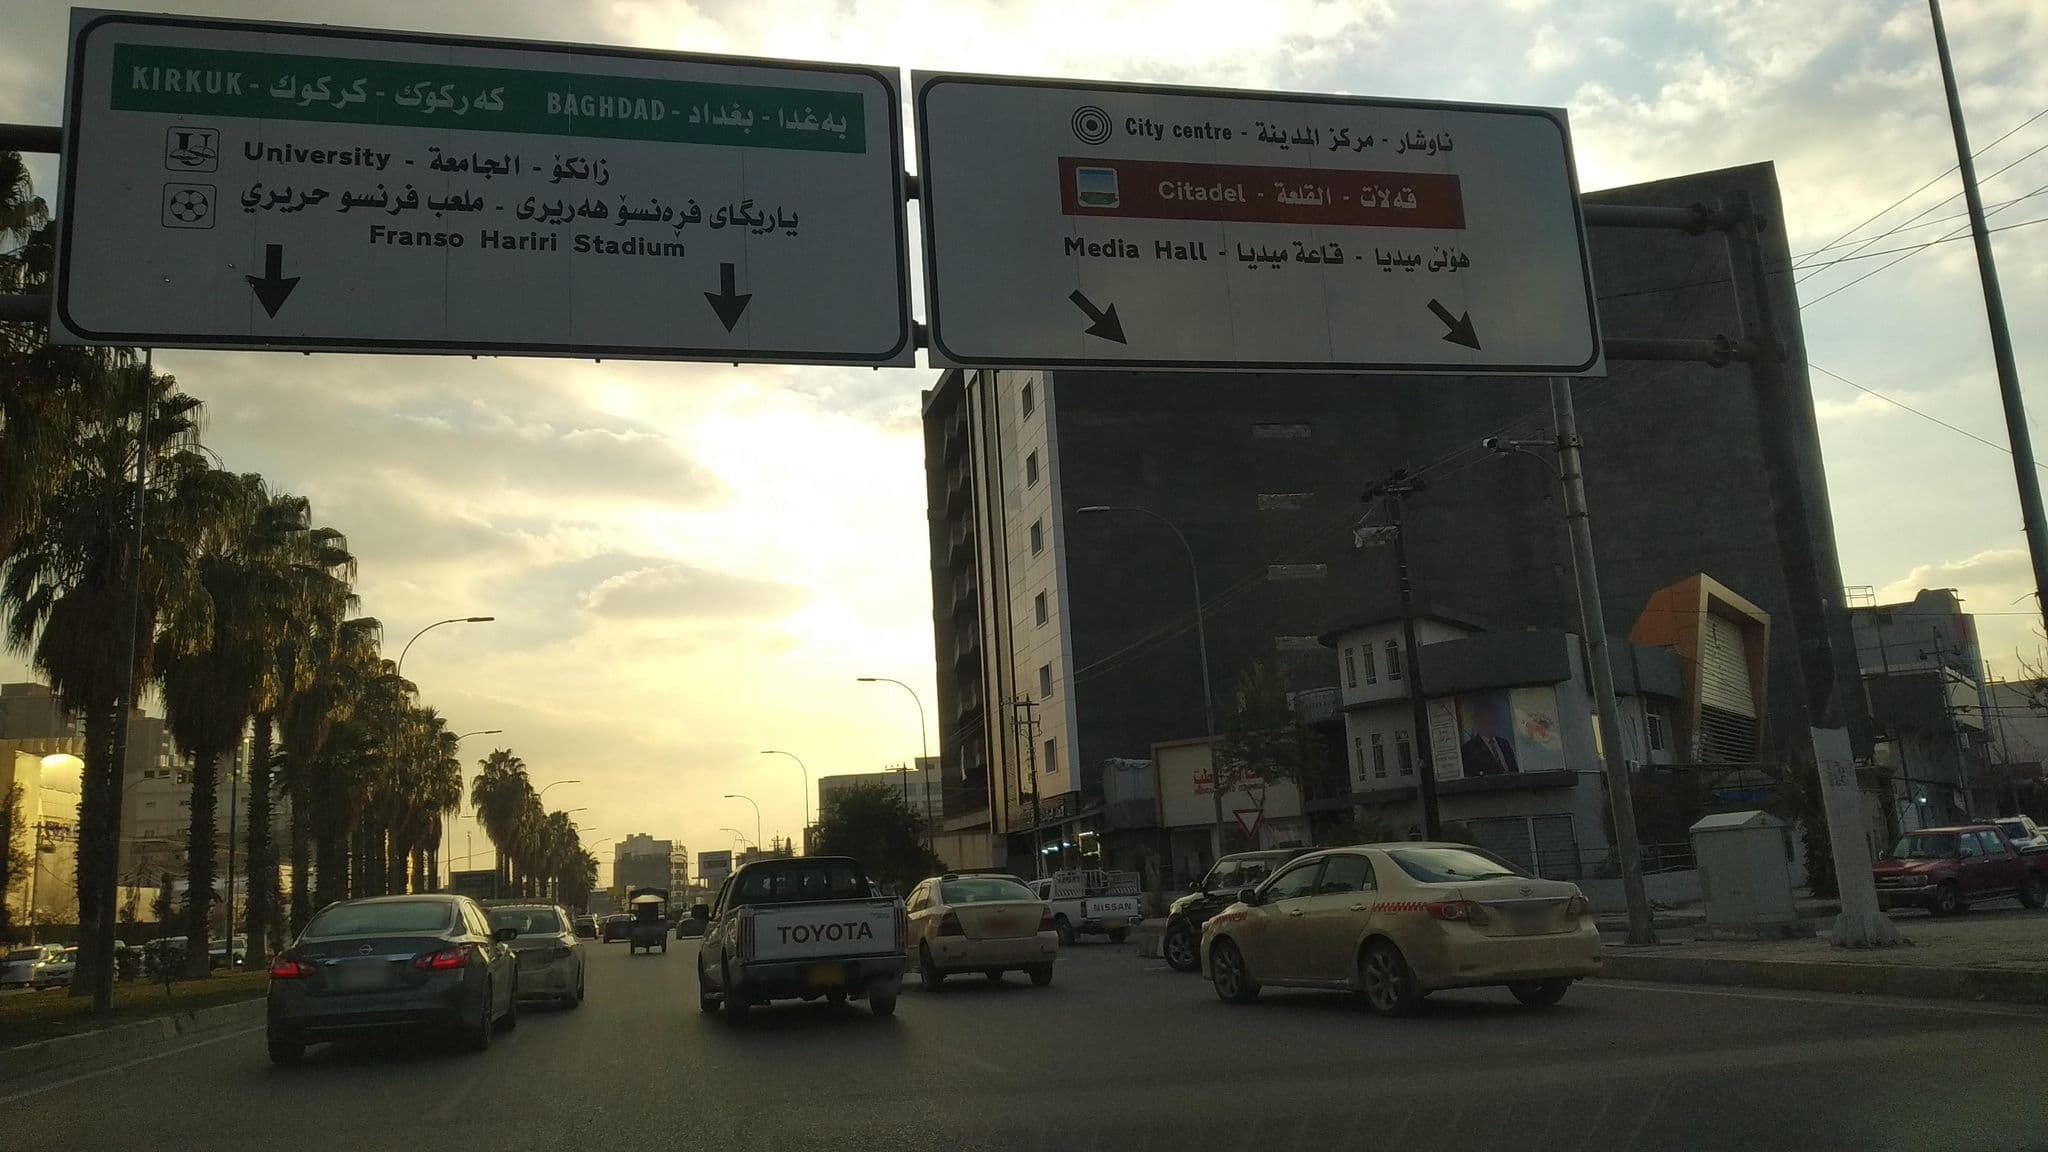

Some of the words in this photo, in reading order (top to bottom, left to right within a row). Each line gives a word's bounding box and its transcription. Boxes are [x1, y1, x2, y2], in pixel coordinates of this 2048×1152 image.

[132, 66, 244, 96] KIRKUK
[269, 74, 368, 109] كركوك
[546, 91, 665, 121] BAGHDAD
[688, 102, 753, 135] بغداد
[1126, 117, 1164, 141] City
[1173, 122, 1232, 141] centre
[1255, 121, 1319, 150] المدينة
[1328, 127, 1374, 153] مركز
[1397, 129, 1453, 155] ناوشار
[244, 141, 390, 171] University
[428, 145, 520, 179] الجامعة
[336, 183, 419, 215] فرنسو
[427, 189, 484, 218] ملعب
[1158, 180, 1246, 204] Citadel
[1273, 181, 1332, 206] القلعة
[370, 225, 464, 248] Franso
[481, 229, 557, 251] Hariri
[573, 233, 685, 257] Stadium
[1064, 237, 1140, 259] Media
[1155, 240, 1208, 261] Hall
[1292, 240, 1344, 264] قاعة
[1093, 902, 1132, 912] NISSAN
[776, 921, 874, 945] TOYOTA
